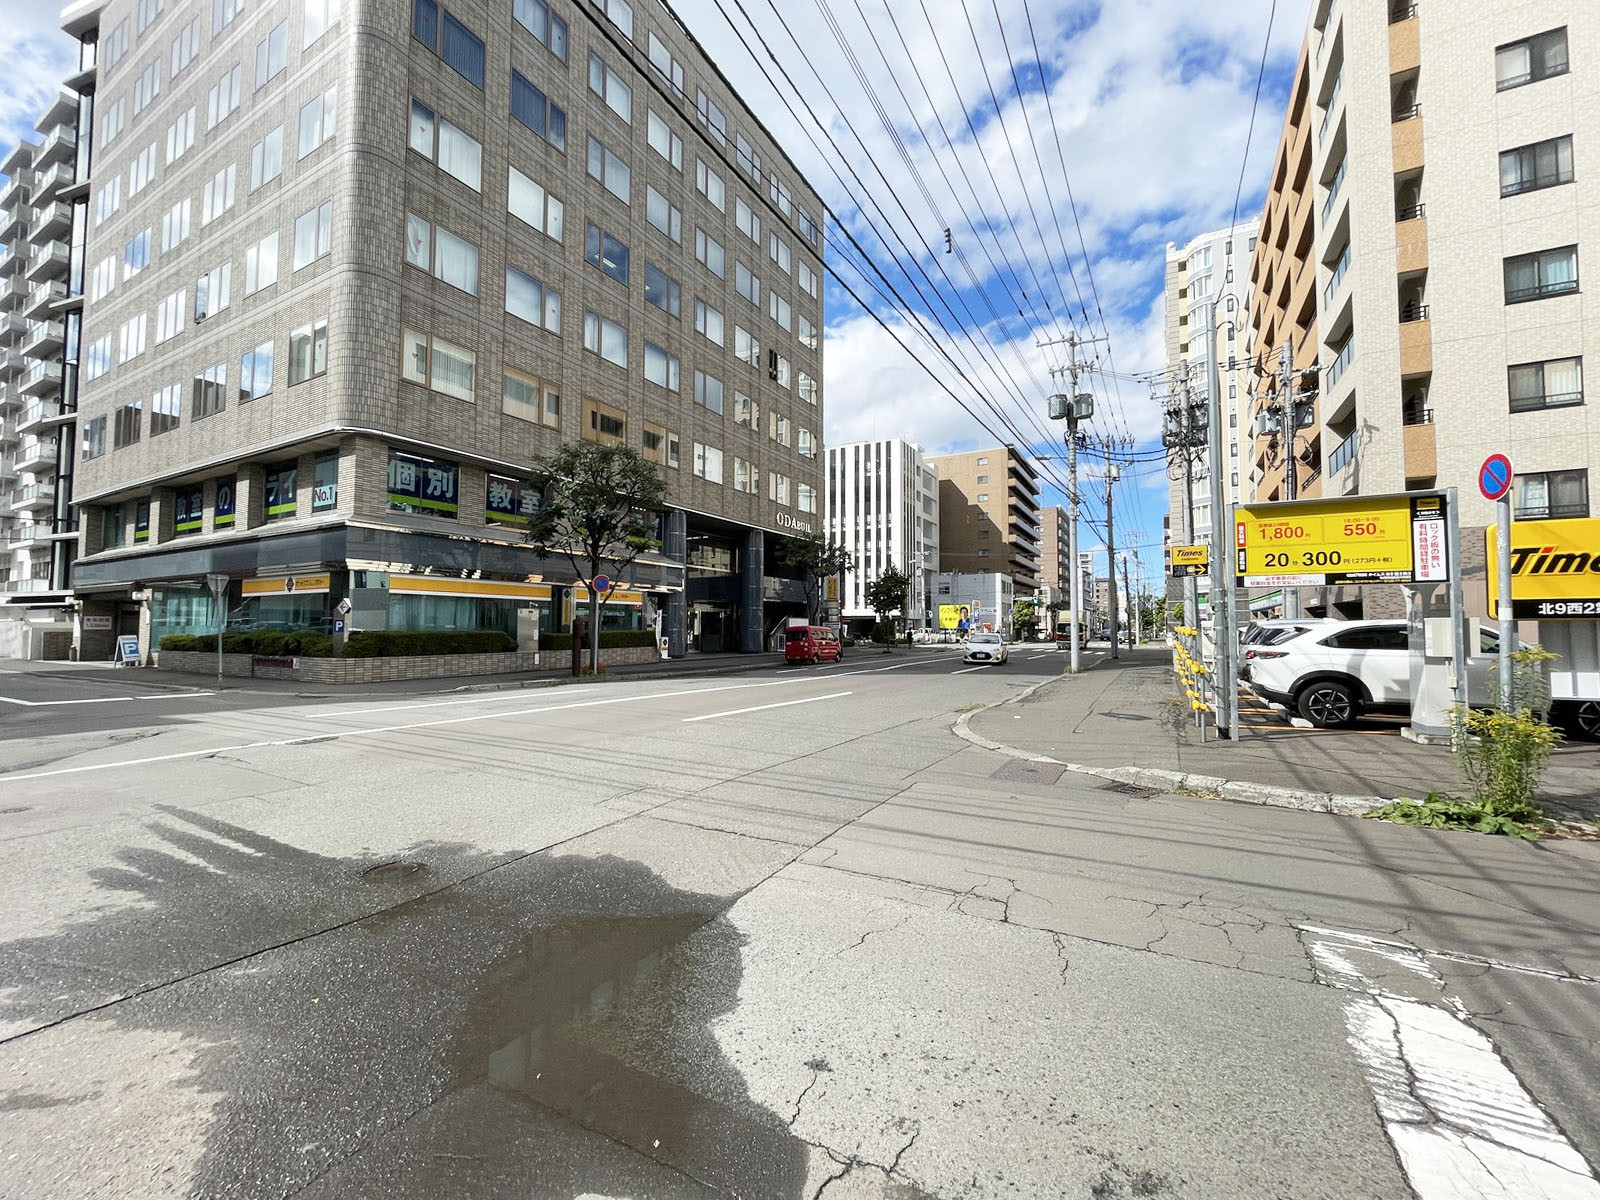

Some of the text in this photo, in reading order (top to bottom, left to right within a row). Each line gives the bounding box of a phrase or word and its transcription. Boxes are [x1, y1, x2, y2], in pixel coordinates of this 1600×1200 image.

[388, 459, 541, 514] 個別 教室
[314, 487, 333, 503] No.1
[1430, 522, 1440, 568] ロック板の無い
[335, 621, 343, 632] P
[124, 643, 137, 654] P
